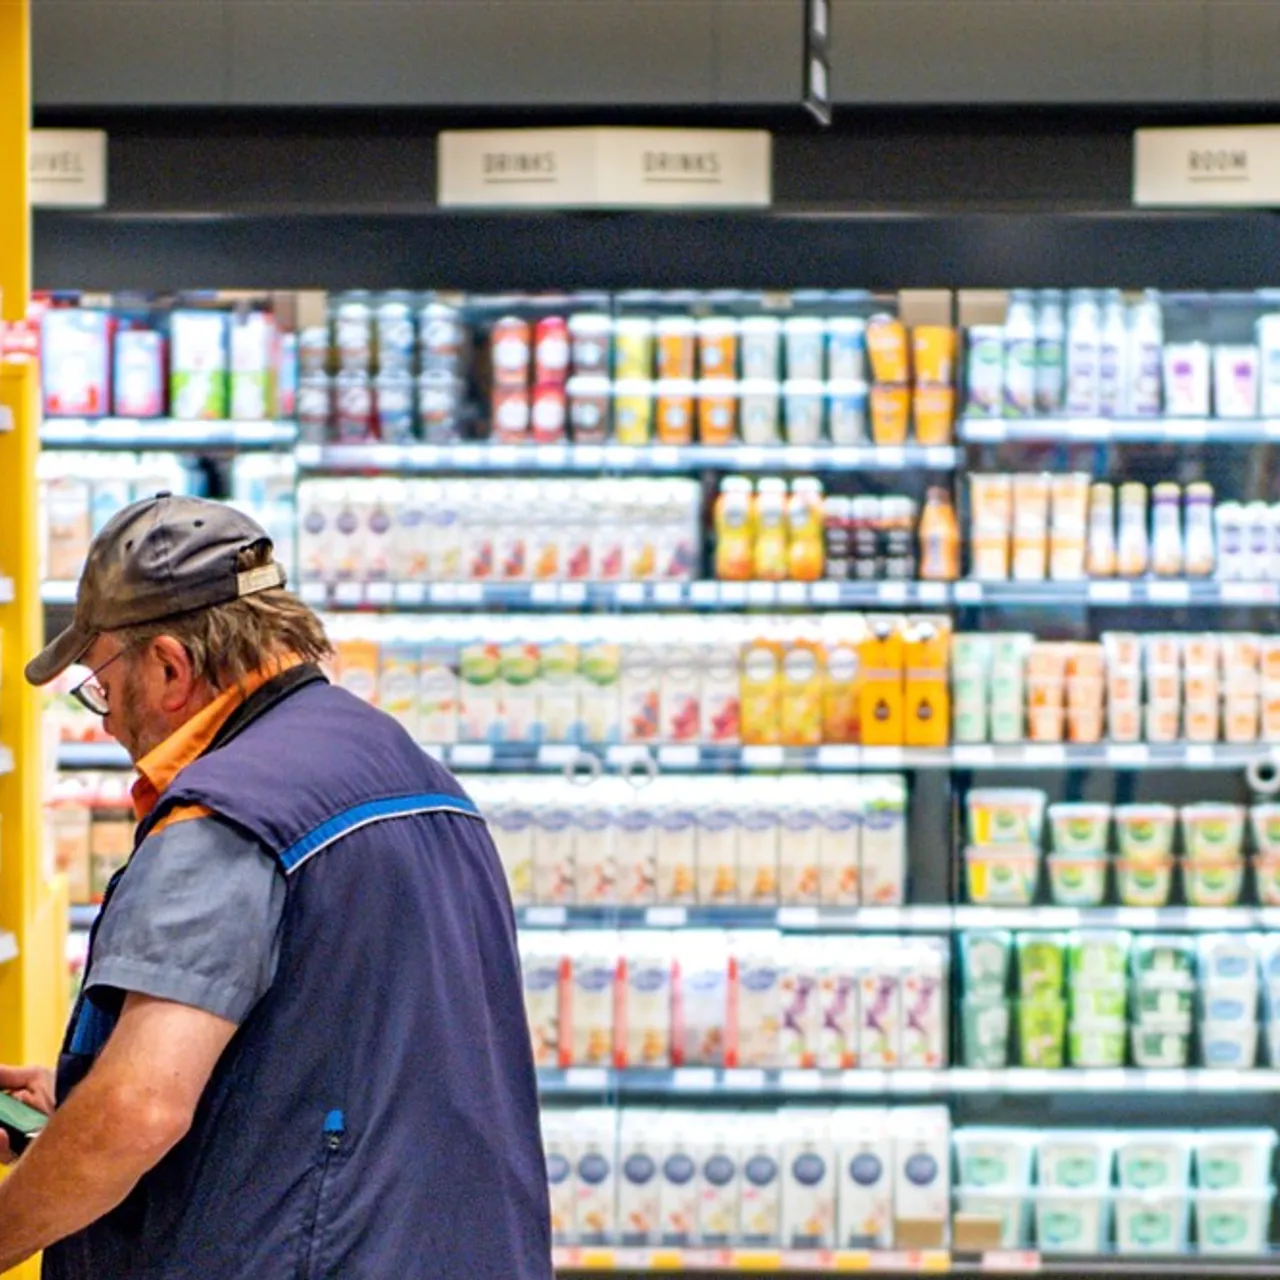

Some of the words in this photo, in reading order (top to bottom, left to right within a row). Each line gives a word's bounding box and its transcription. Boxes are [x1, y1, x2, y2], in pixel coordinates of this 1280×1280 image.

[483, 152, 556, 174] DRINKS
[644, 152, 721, 173] DRINKS
[1188, 150, 1248, 171] ROOM
